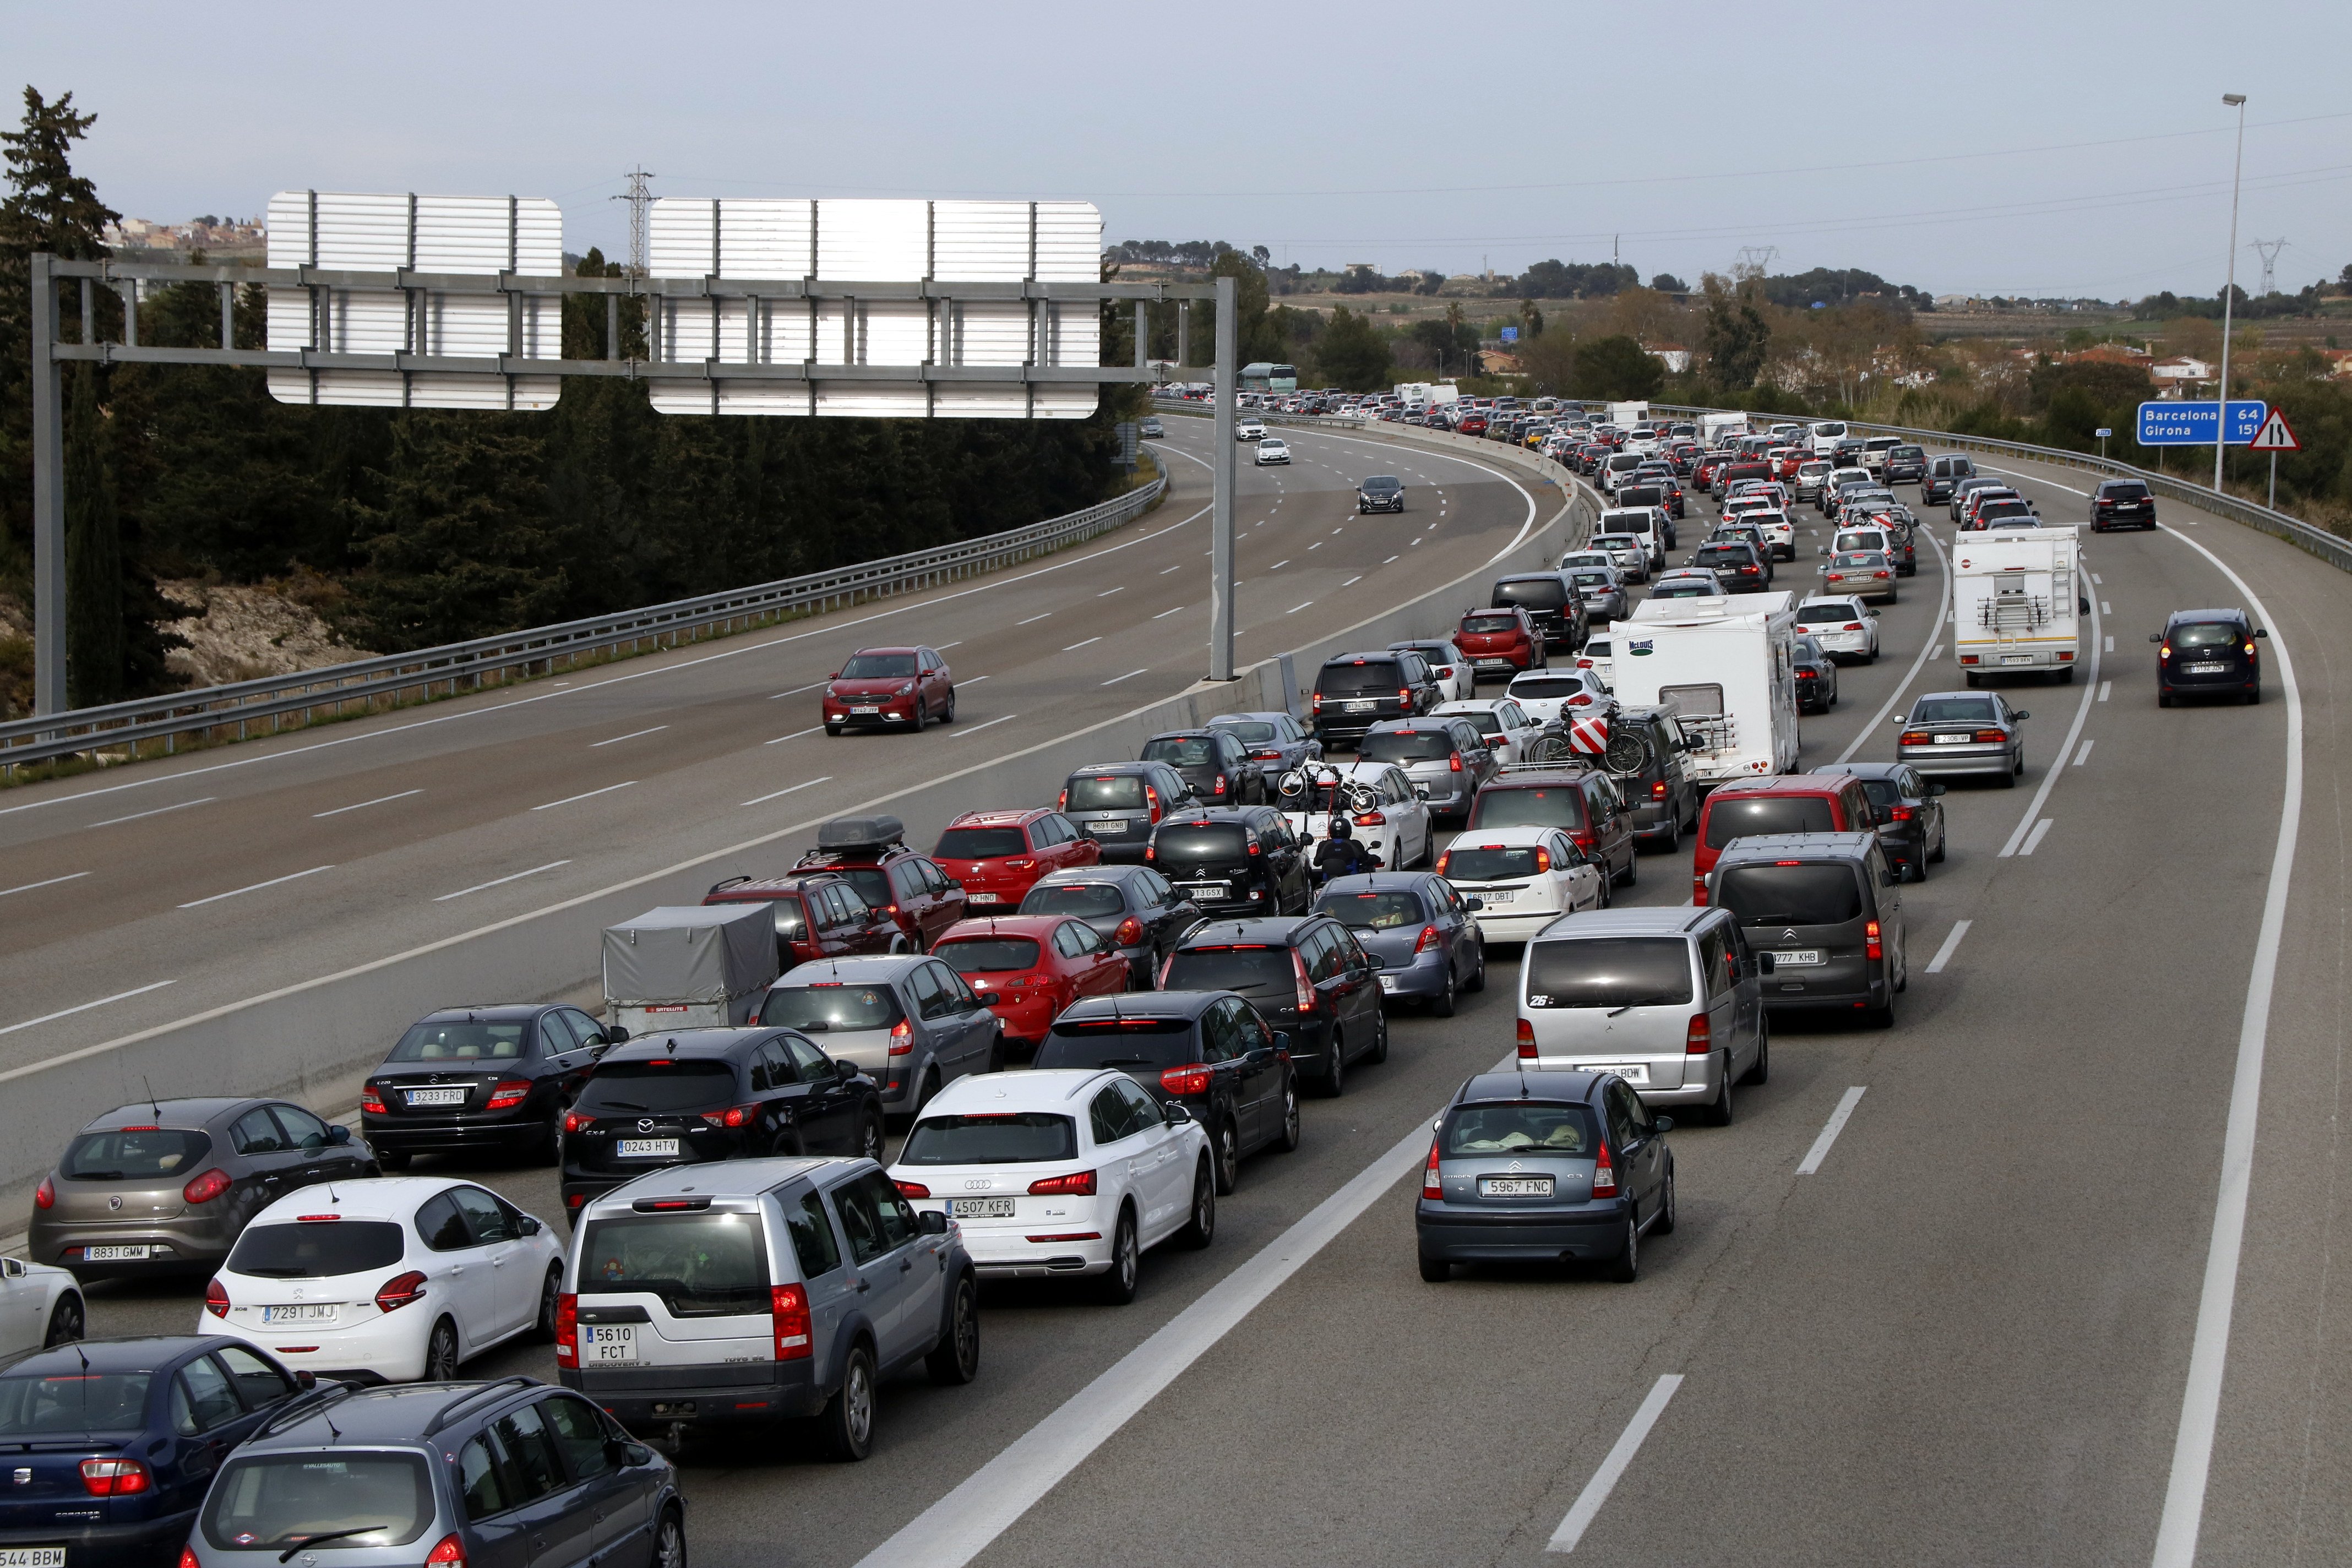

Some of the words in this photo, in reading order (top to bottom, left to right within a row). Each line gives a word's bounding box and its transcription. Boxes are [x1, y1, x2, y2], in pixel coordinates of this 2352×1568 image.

[2146, 410, 2216, 421] Barcelona
[2238, 410, 2258, 420] 64
[2145, 426, 2191, 435] Girona
[2239, 424, 2257, 435] 151
[1629, 640, 1653, 650] McLOUIS
[1799, 953, 1816, 961] KHB
[1529, 995, 1548, 1006] 26
[1621, 1069, 1640, 1078] BDW
[416, 1092, 440, 1101] 3233
[443, 1091, 462, 1100] FRD
[625, 1142, 651, 1151] 0243
[655, 1141, 676, 1151] HTV
[1491, 1182, 1521, 1192] 5967
[1526, 1180, 1548, 1191] FNC
[955, 1201, 984, 1213] 4507
[989, 1200, 1010, 1212] KFR
[94, 1248, 118, 1258] 8831
[123, 1247, 143, 1257] GMM
[273, 1306, 304, 1319] 7291
[309, 1305, 334, 1318] JMJ
[597, 1328, 631, 1341] 5610
[601, 1346, 627, 1359] FCT
[32, 1550, 62, 1566] BBM
